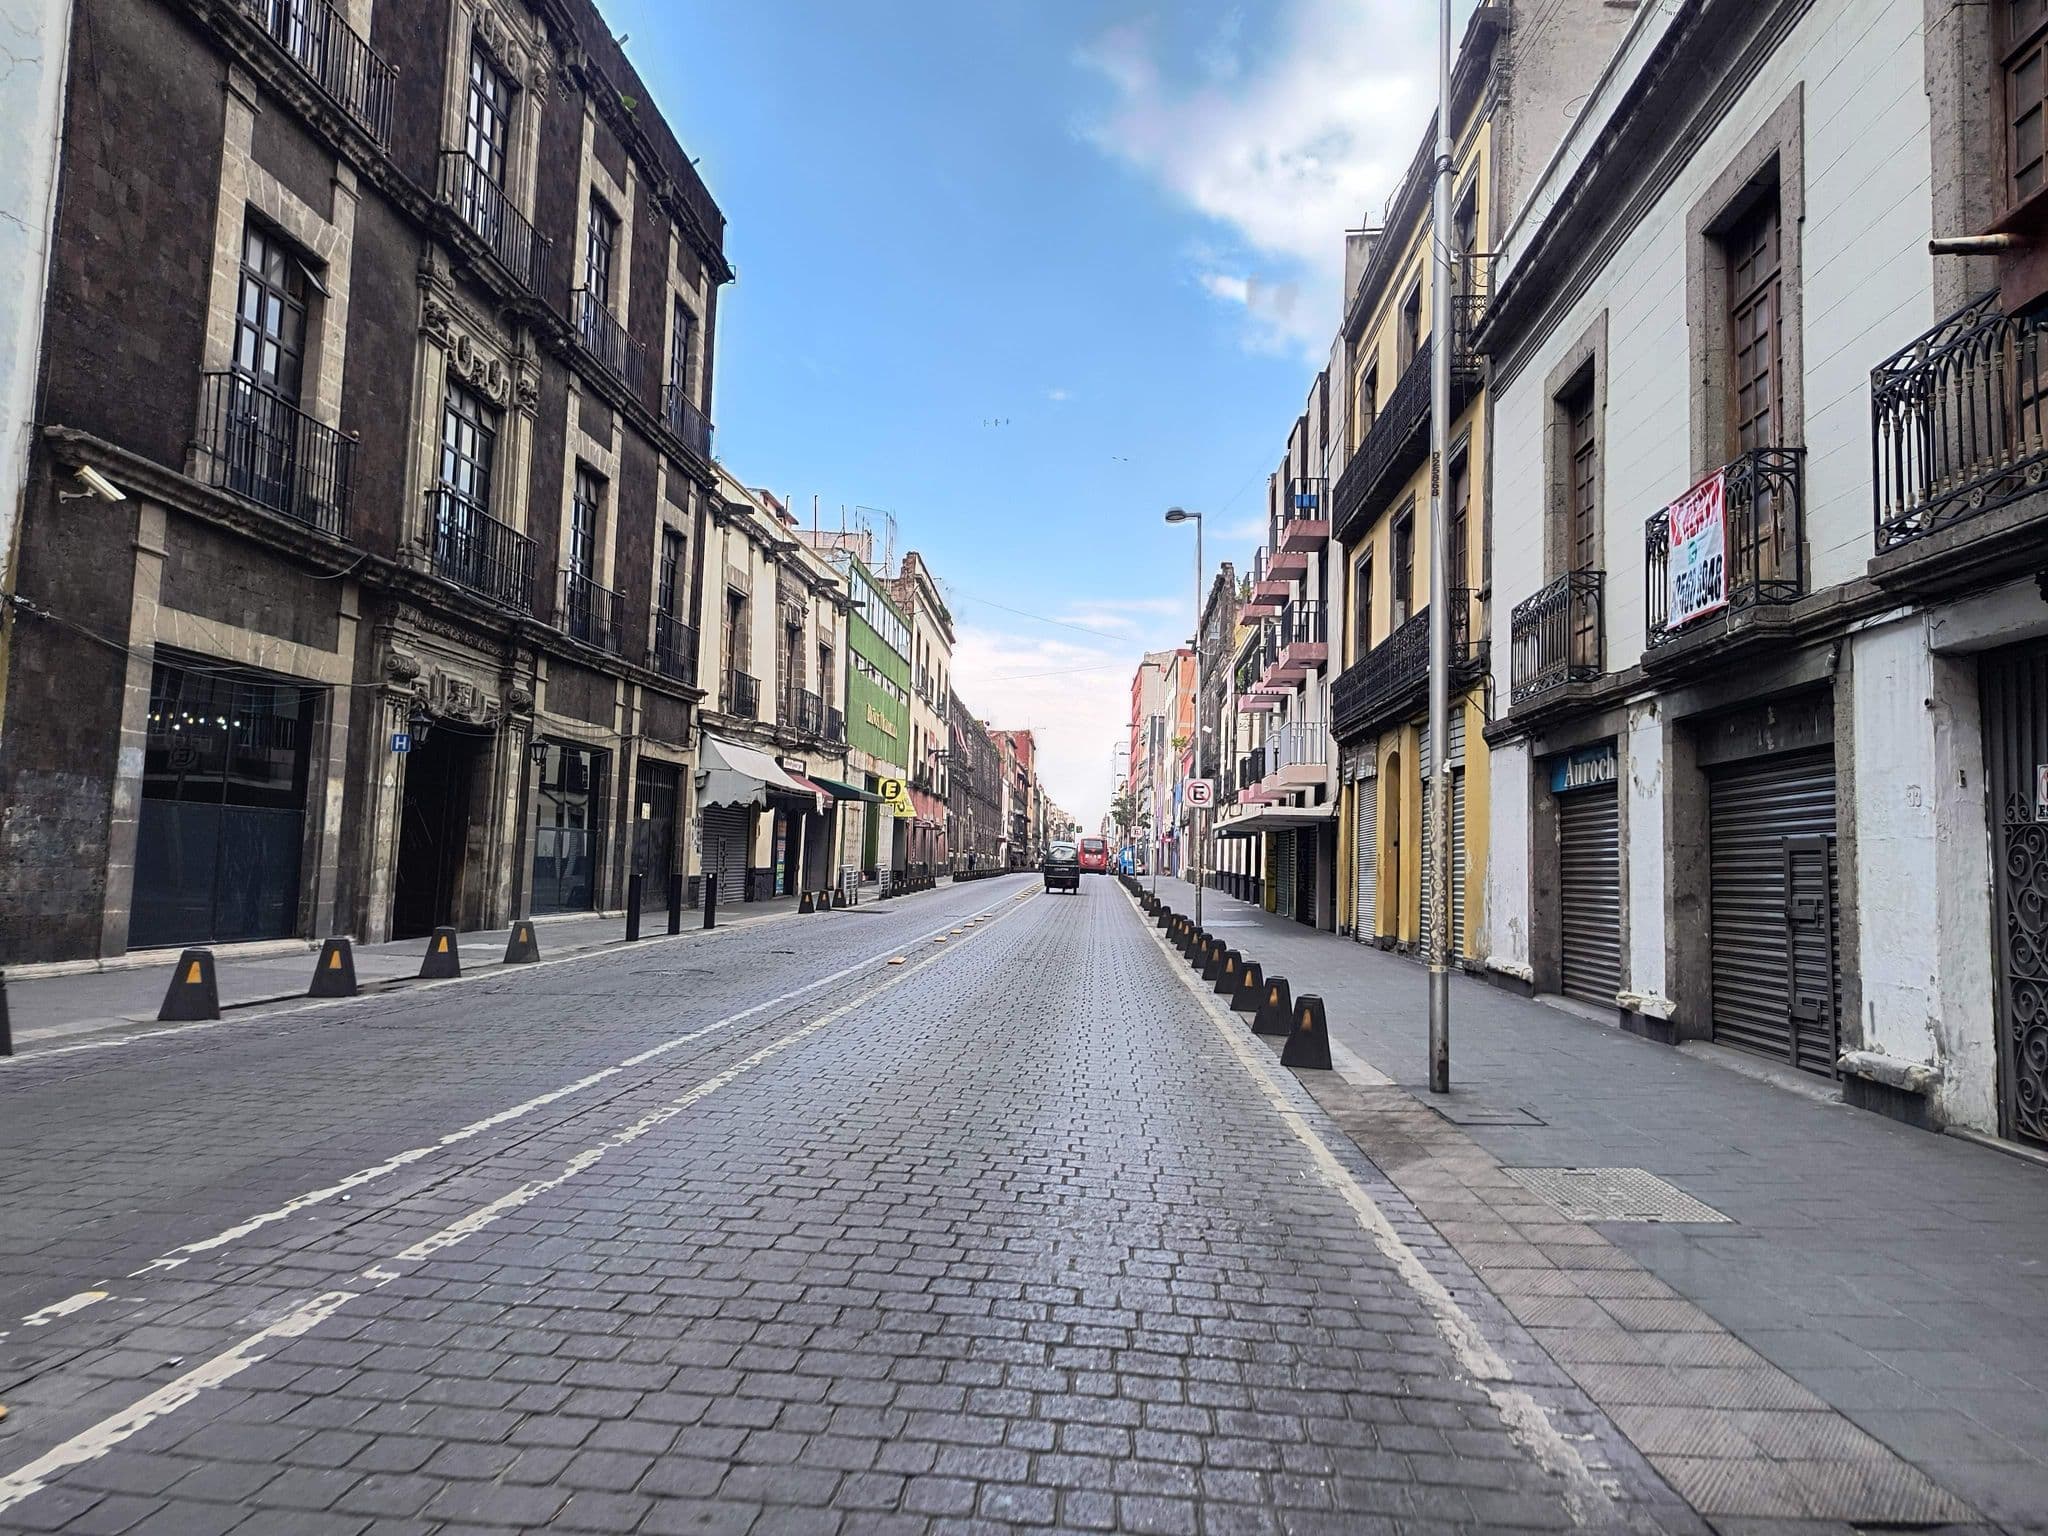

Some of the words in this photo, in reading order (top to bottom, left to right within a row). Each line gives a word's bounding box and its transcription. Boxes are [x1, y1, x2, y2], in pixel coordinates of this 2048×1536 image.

[395, 735, 407, 750] H
[885, 781, 898, 798] E
[1193, 785, 1205, 800] E
